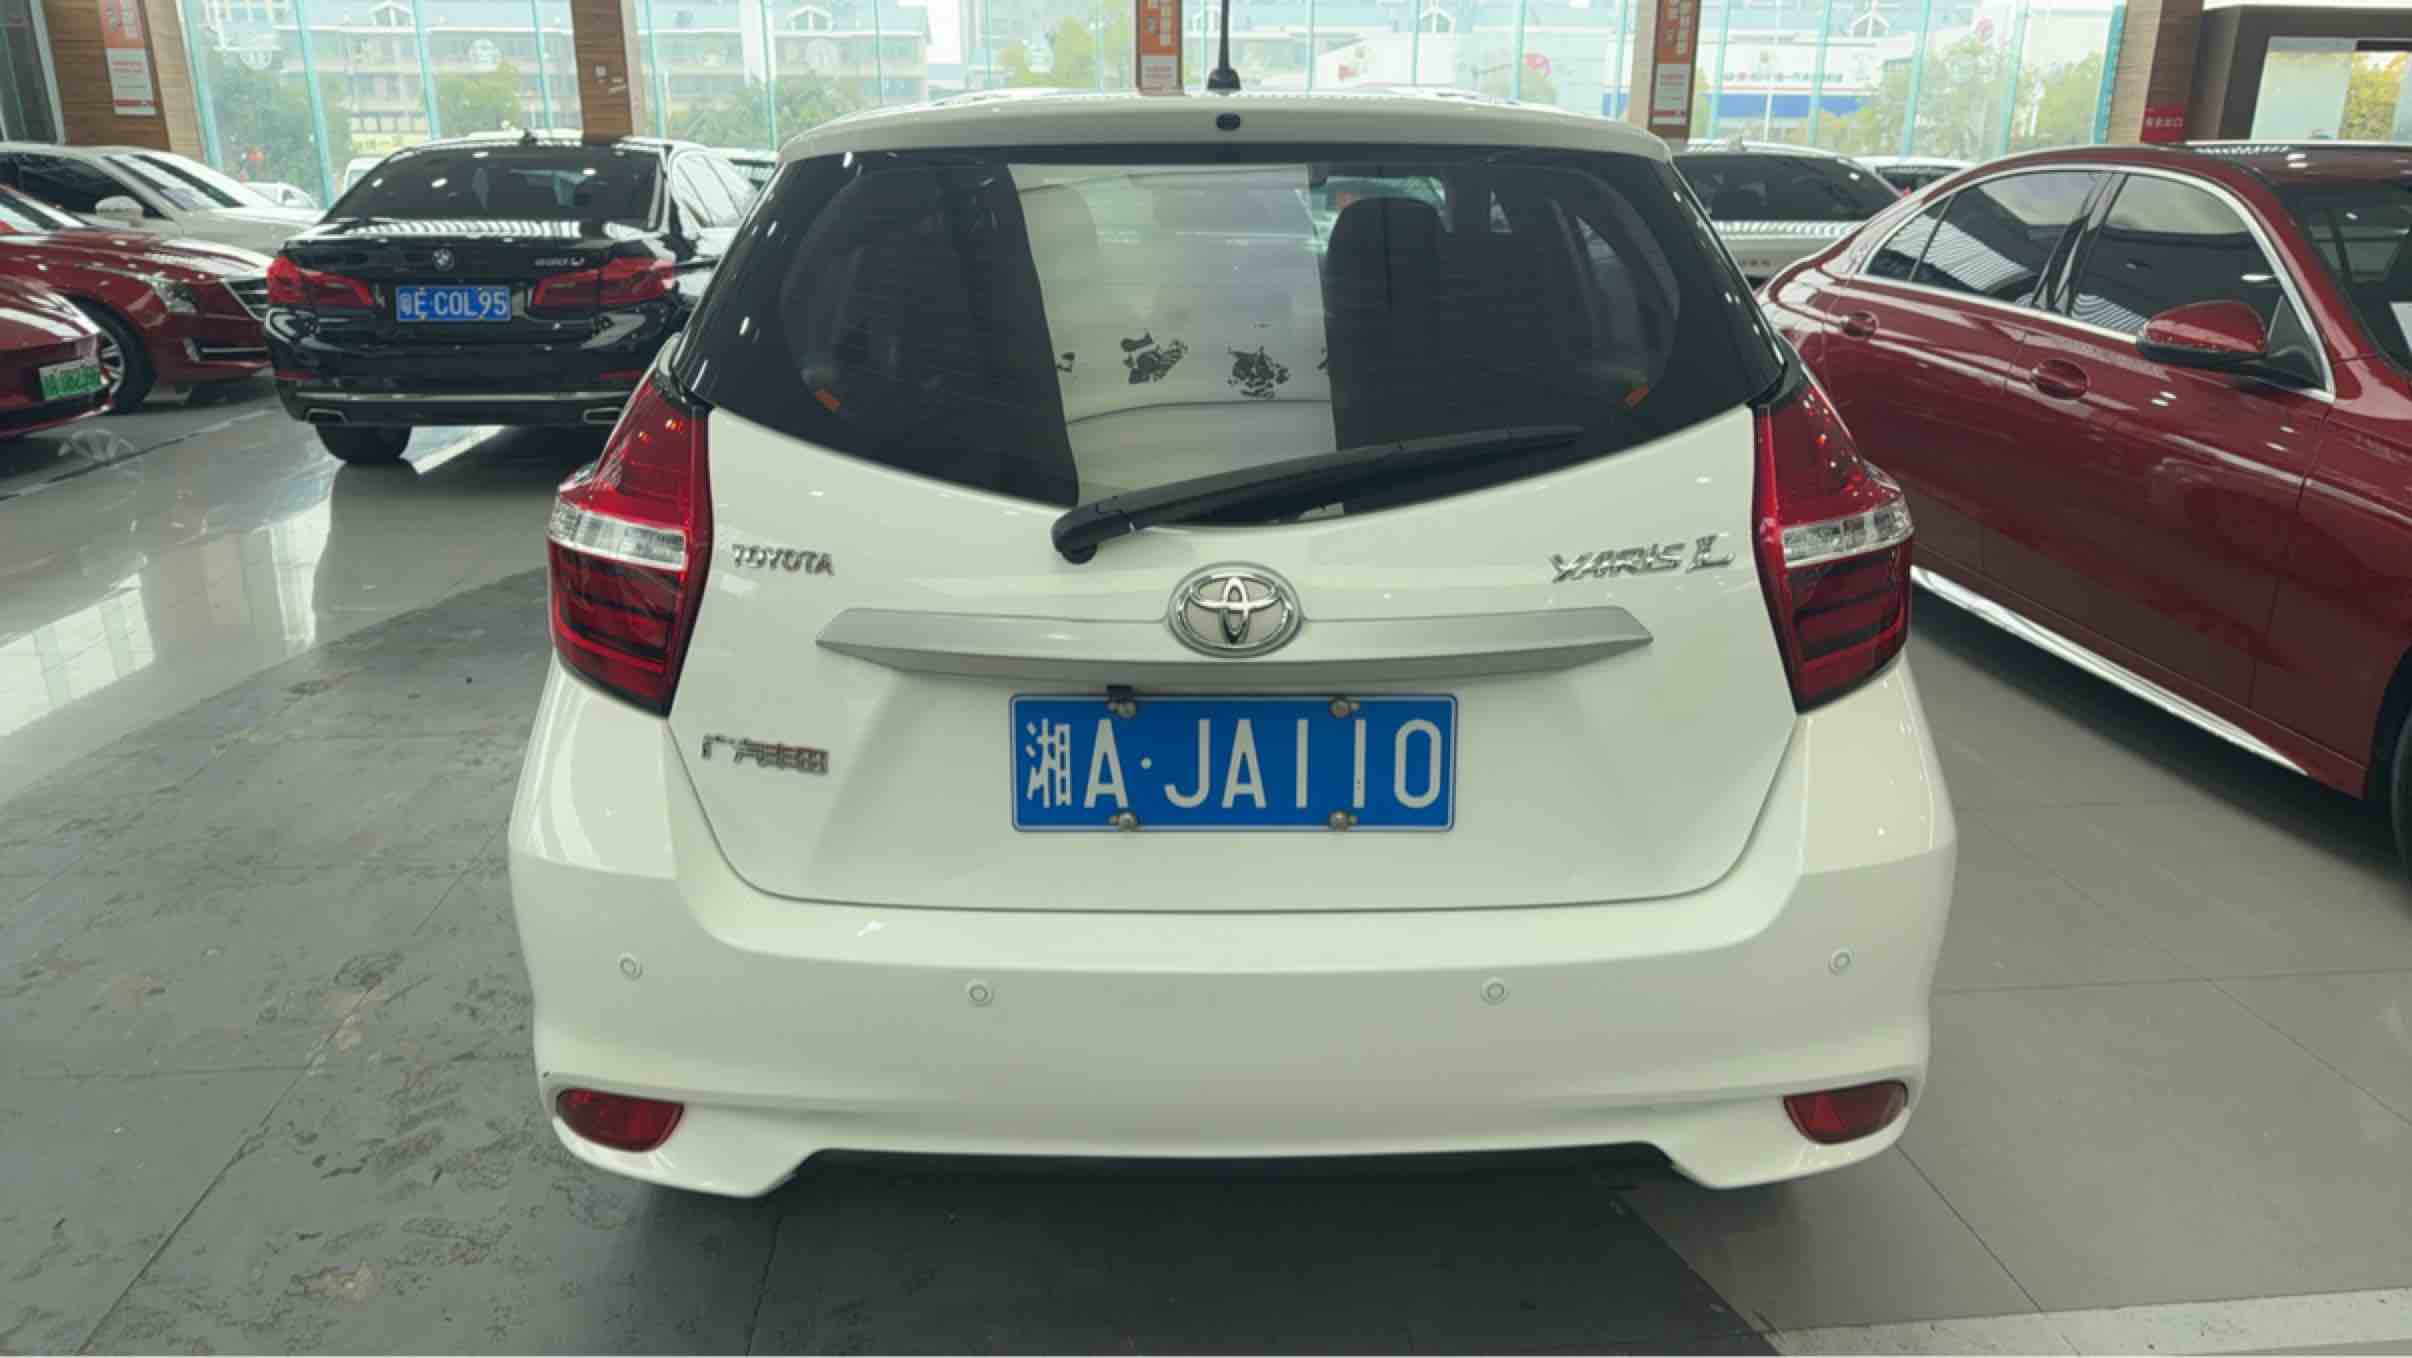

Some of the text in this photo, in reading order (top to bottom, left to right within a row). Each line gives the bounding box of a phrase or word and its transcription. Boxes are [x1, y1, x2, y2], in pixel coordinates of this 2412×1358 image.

[732, 544, 834, 576] TOYOTA
[1550, 534, 1736, 583] YARIS L
[702, 734, 829, 775] 广汽丰田
